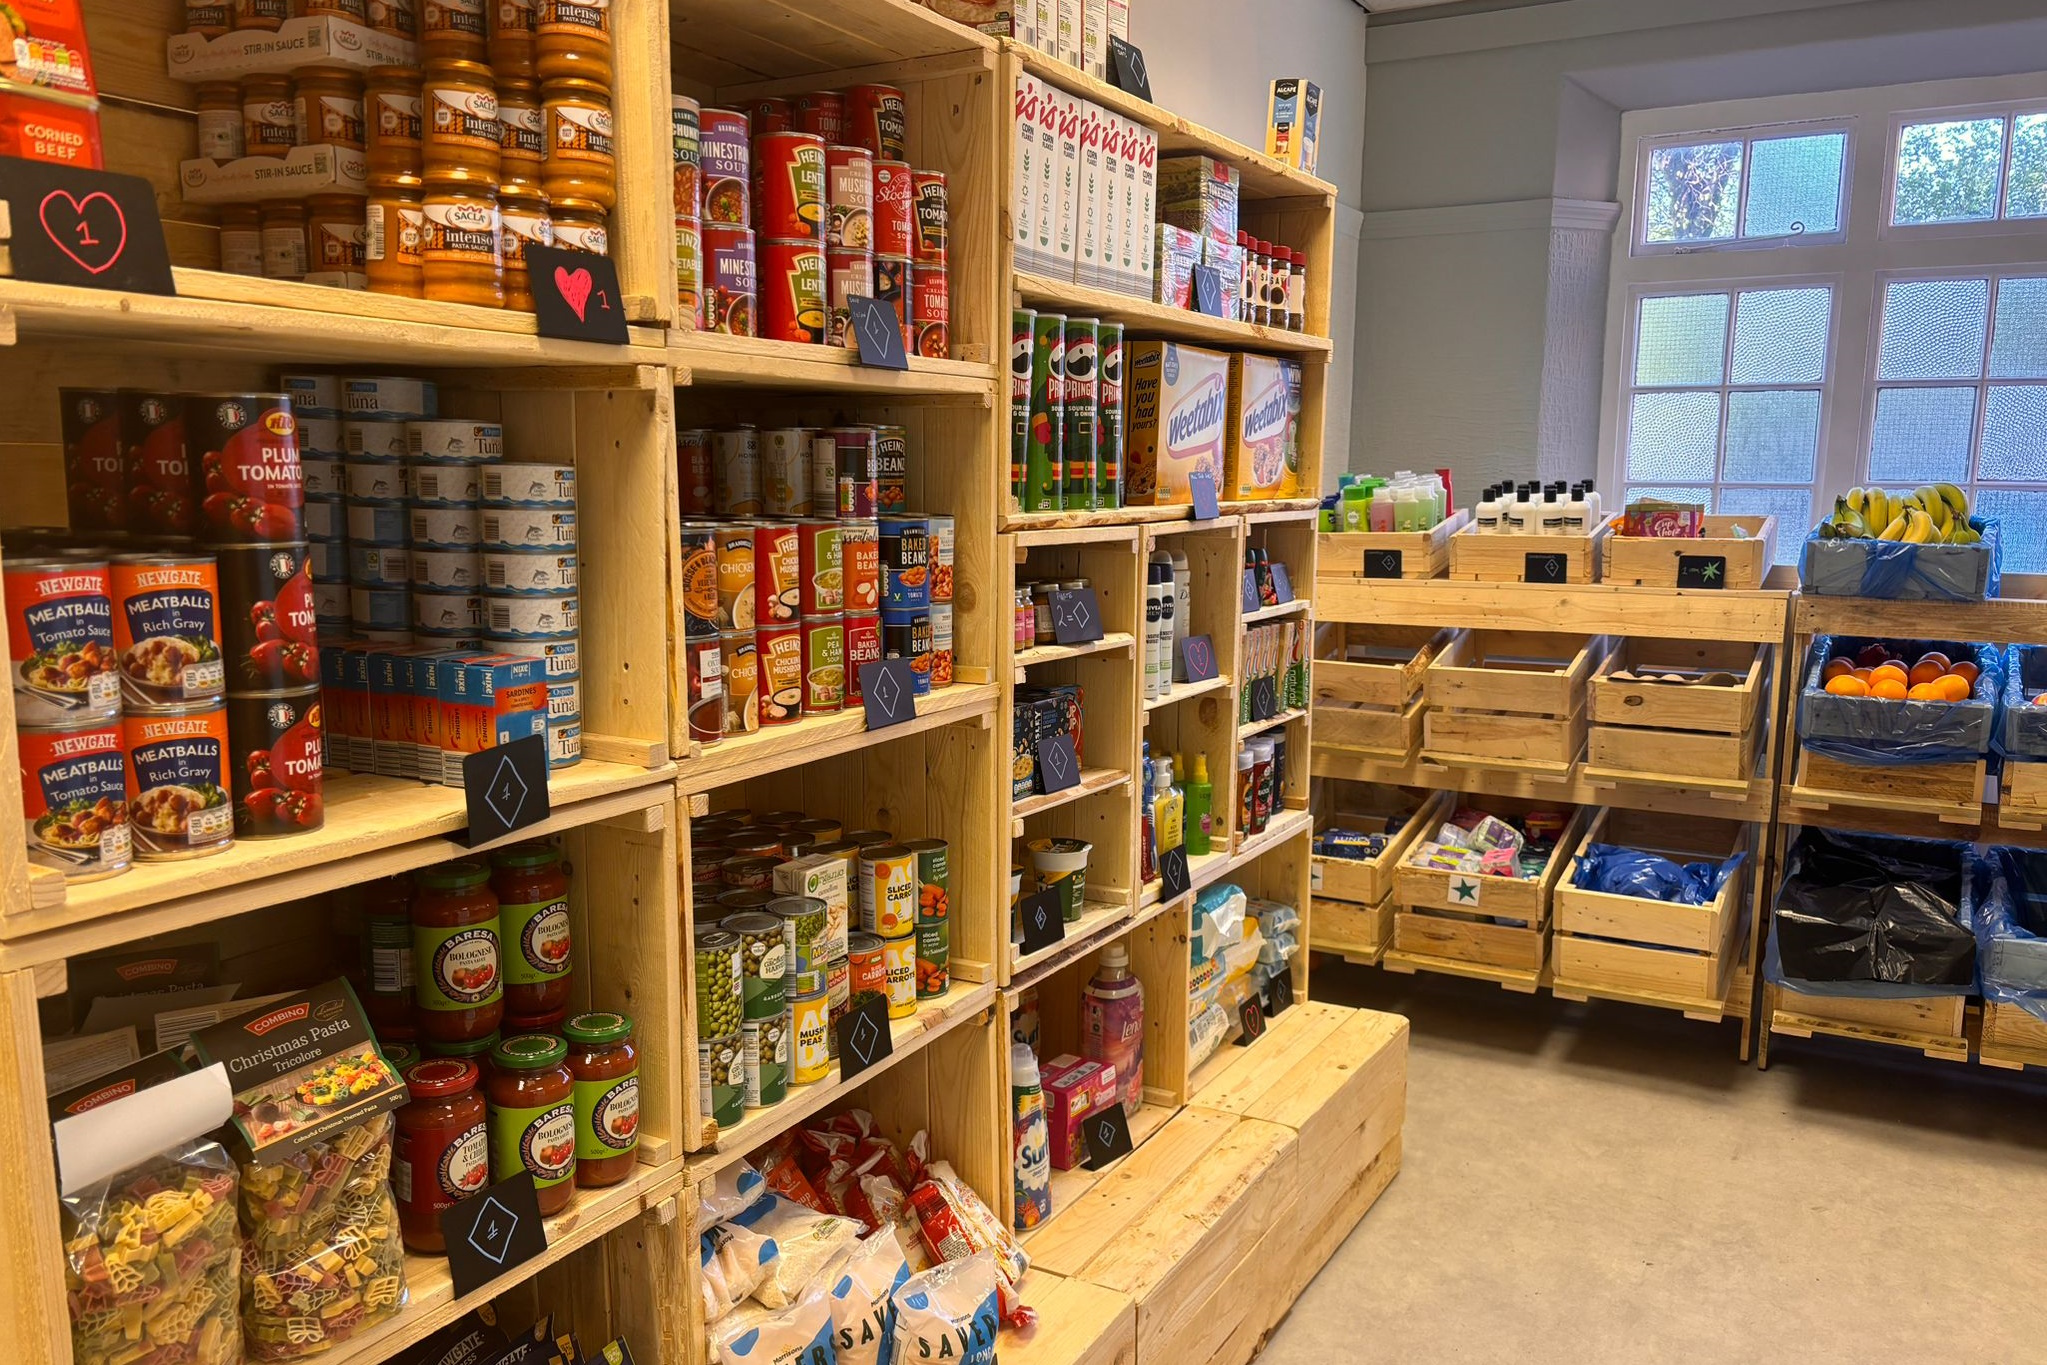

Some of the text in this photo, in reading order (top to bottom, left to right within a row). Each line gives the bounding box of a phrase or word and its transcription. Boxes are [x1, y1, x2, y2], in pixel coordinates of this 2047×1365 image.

[558, 4, 600, 21] intenso
[579, 18, 596, 26] SAUCE
[244, 38, 304, 55] STIR-IN SAUCE
[24, 124, 83, 147] CORNED
[1022, 123, 1034, 134] CORN
[1021, 132, 1034, 143] FLAKES
[1042, 133, 1054, 144] CORN
[34, 141, 77, 160] BEEF
[1042, 141, 1053, 152] FLAKES
[1064, 142, 1075, 153] CORN
[1064, 150, 1074, 160] FLAKES
[1086, 149, 1097, 160] CORN
[1106, 156, 1117, 167] CORN
[255, 164, 313, 180] STIR-IN SAUCE
[716, 160, 746, 173] SOUP
[1124, 163, 1135, 174] CORN
[1142, 170, 1152, 180] CORN
[75, 221, 99, 244] 1
[446, 230, 493, 245] intenso
[452, 243, 488, 251] PASTA SAUCE
[597, 289, 610, 310] 1
[1135, 378, 1157, 391] Have
[1136, 392, 1154, 406] you
[1136, 405, 1154, 419] had
[1132, 419, 1157, 432] yours?
[901, 538, 926, 551] BAKED
[901, 551, 926, 565] BEANS
[39, 577, 103, 595] NEWGATE
[137, 571, 202, 587] NEWGATE
[128, 597, 210, 615] MEATBALLS
[29, 604, 110, 626] MEATBALLS
[76, 618, 84, 626] in
[143, 617, 205, 633] Rich Gravy
[37, 624, 111, 645] Tomato Sauce
[850, 648, 879, 661] BEANS
[548, 657, 576, 671] Tuna
[506, 687, 537, 698] SARDINES
[143, 721, 208, 738] NEWGATE
[53, 734, 117, 756] NEWGATE
[136, 745, 218, 765] MEATBALLS
[43, 759, 123, 785] MEATBALLS
[90, 775, 97, 783] in
[150, 766, 211, 782] Rich Gravy
[51, 781, 123, 802] Tomato Sauce
[887, 882, 911, 894] SLICED
[445, 930, 493, 949] BARESA
[449, 947, 492, 962] BOLOGNESE
[124, 962, 171, 977] COMBINO
[254, 1007, 304, 1032] COMBINO
[800, 1025, 826, 1038] MUSHY
[230, 1018, 350, 1074] Christmas Pasta
[800, 1036, 822, 1047] PEAS
[273, 1047, 322, 1073] Tricolore
[77, 1084, 132, 1113] COMBINO
[389, 1094, 402, 1103] 500g
[294, 1104, 377, 1144] Colourful Christmas Themed Pasta
[462, 1155, 469, 1163] &
[871, 1289, 889, 1307] Morrisons
[951, 1313, 972, 1325] Morrisons
[773, 1346, 803, 1364] Morrisons
